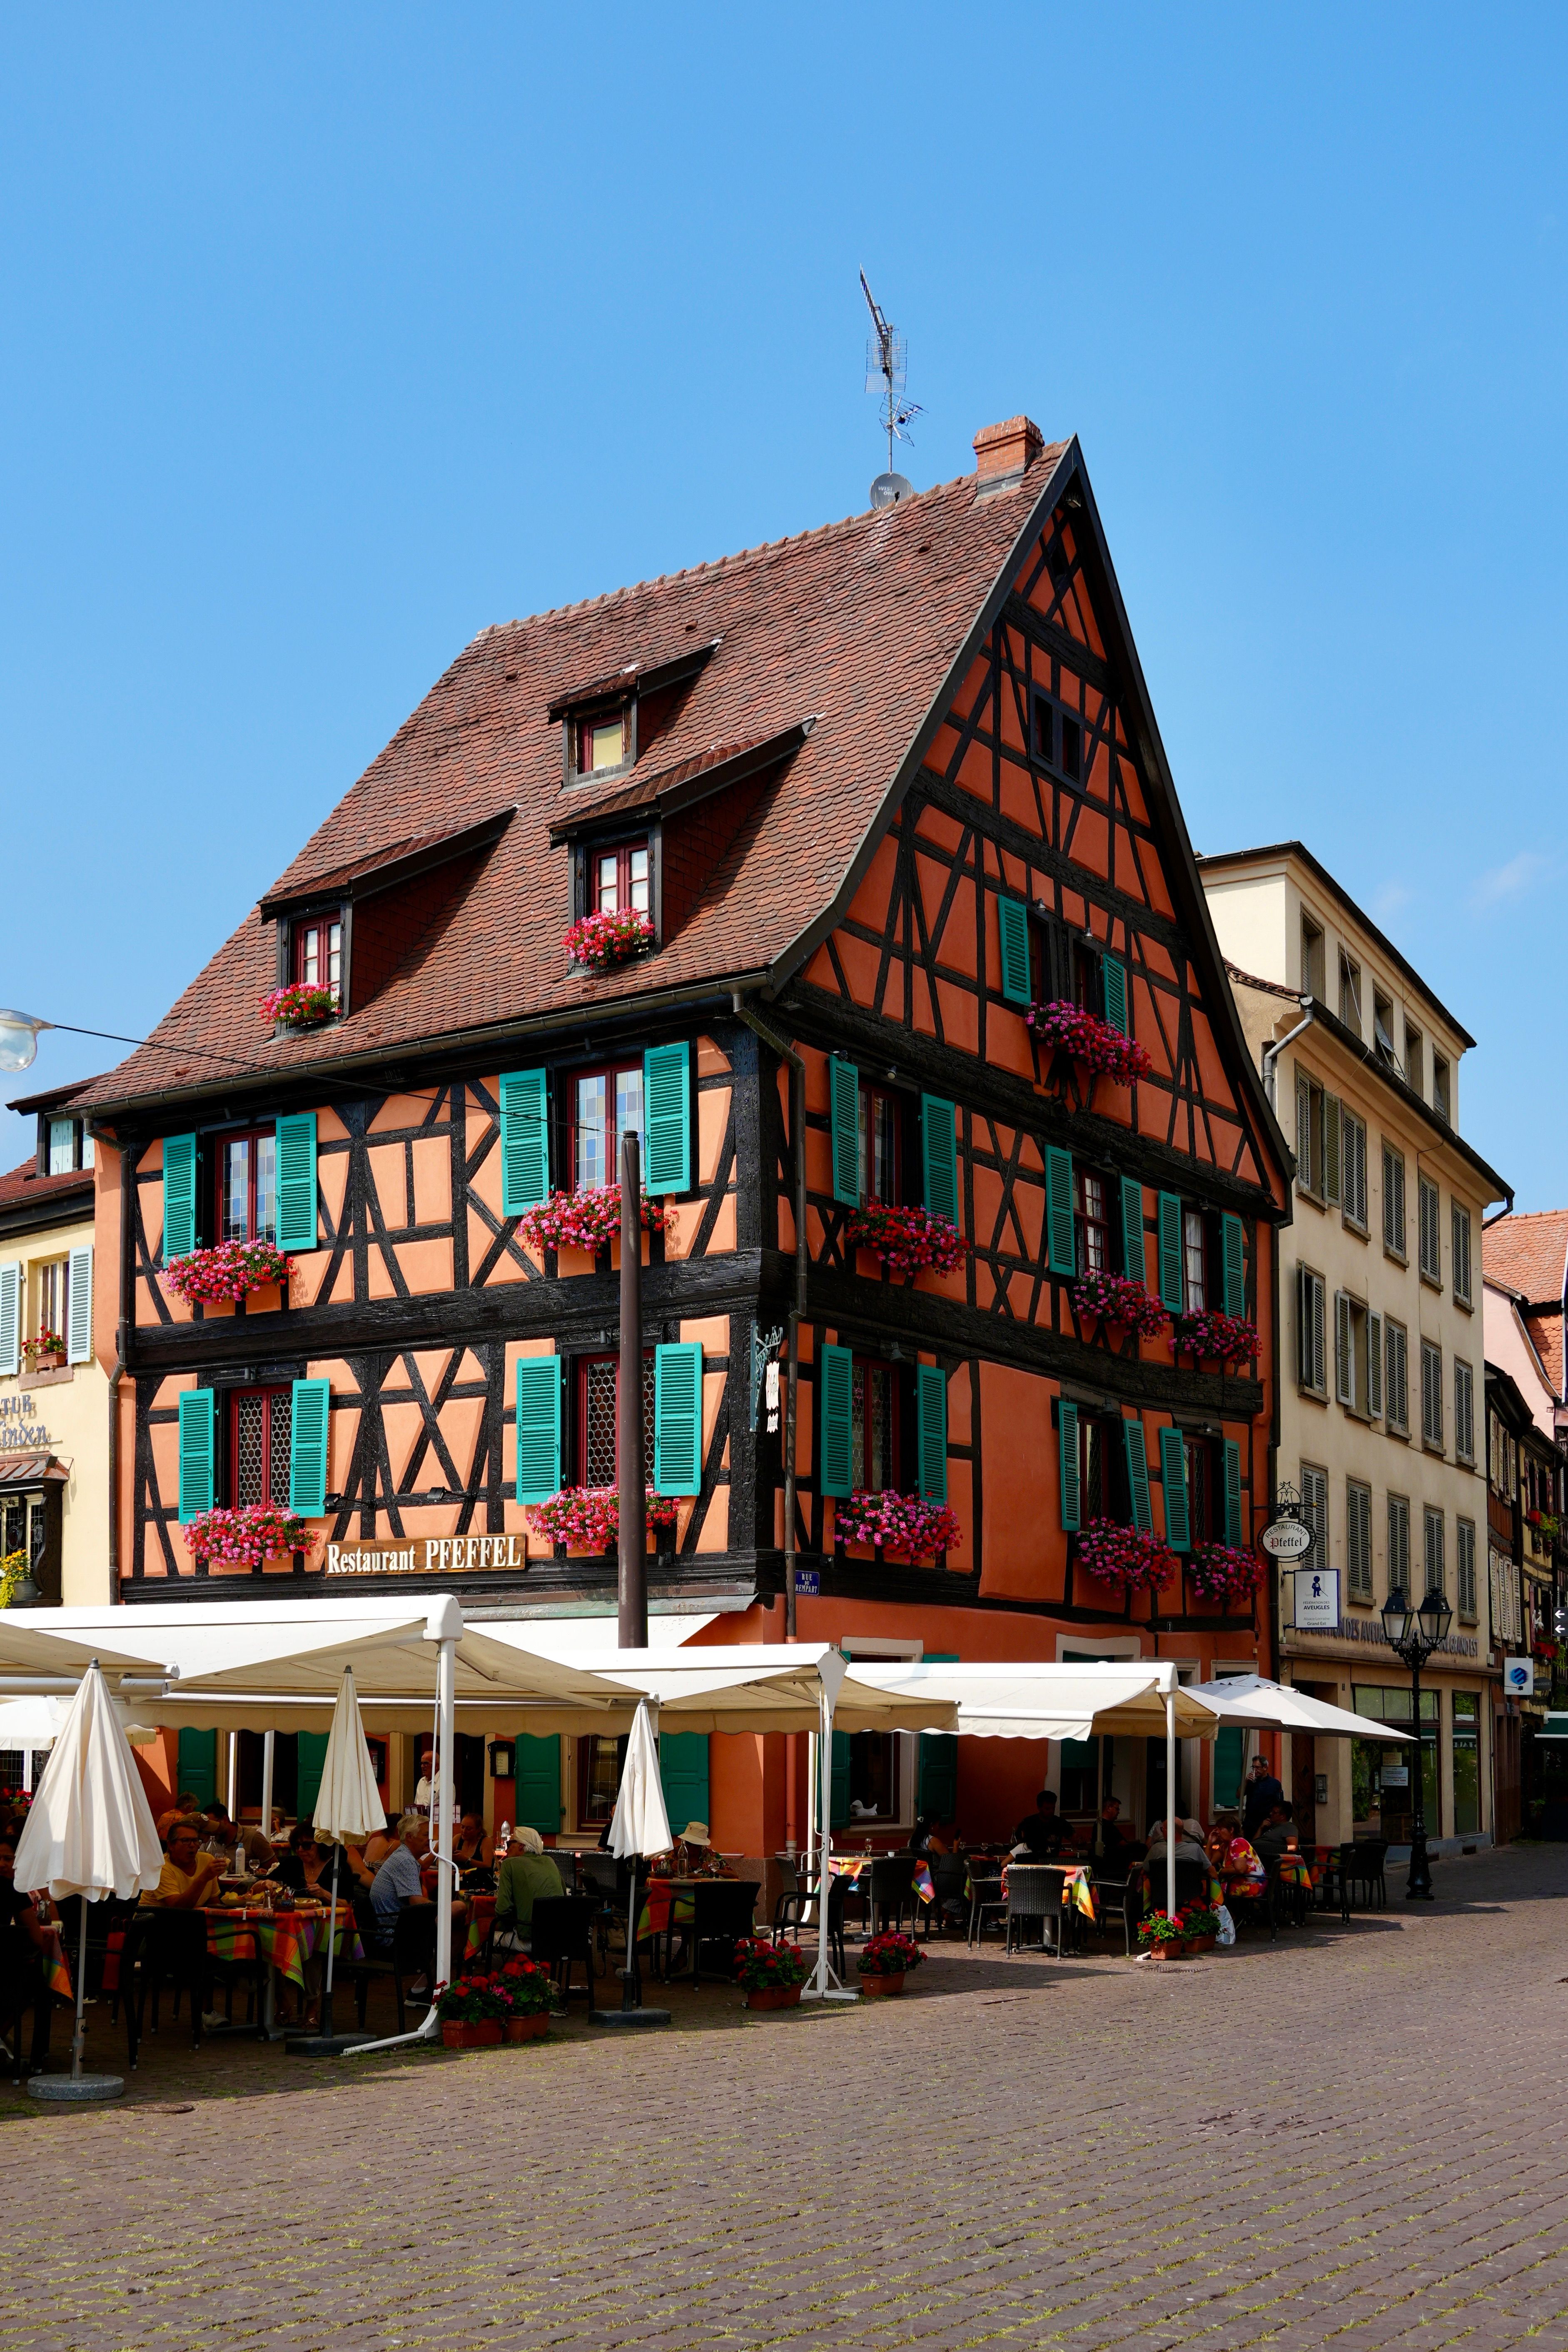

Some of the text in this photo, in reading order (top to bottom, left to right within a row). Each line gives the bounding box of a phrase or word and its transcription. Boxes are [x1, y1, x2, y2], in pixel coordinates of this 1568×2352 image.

[0, 1395, 32, 1415] TUB
[1265, 1524, 1307, 1538] RESTAURANT
[1269, 1537, 1302, 1549] Pfeffel
[327, 1536, 521, 1574] Restaurant PFEFFEL
[795, 1584, 817, 1593] REMPART
[1346, 1617, 1359, 1639] DES
[1450, 1635, 1469, 1655] GRAND
[1470, 1638, 1478, 1656] EST
